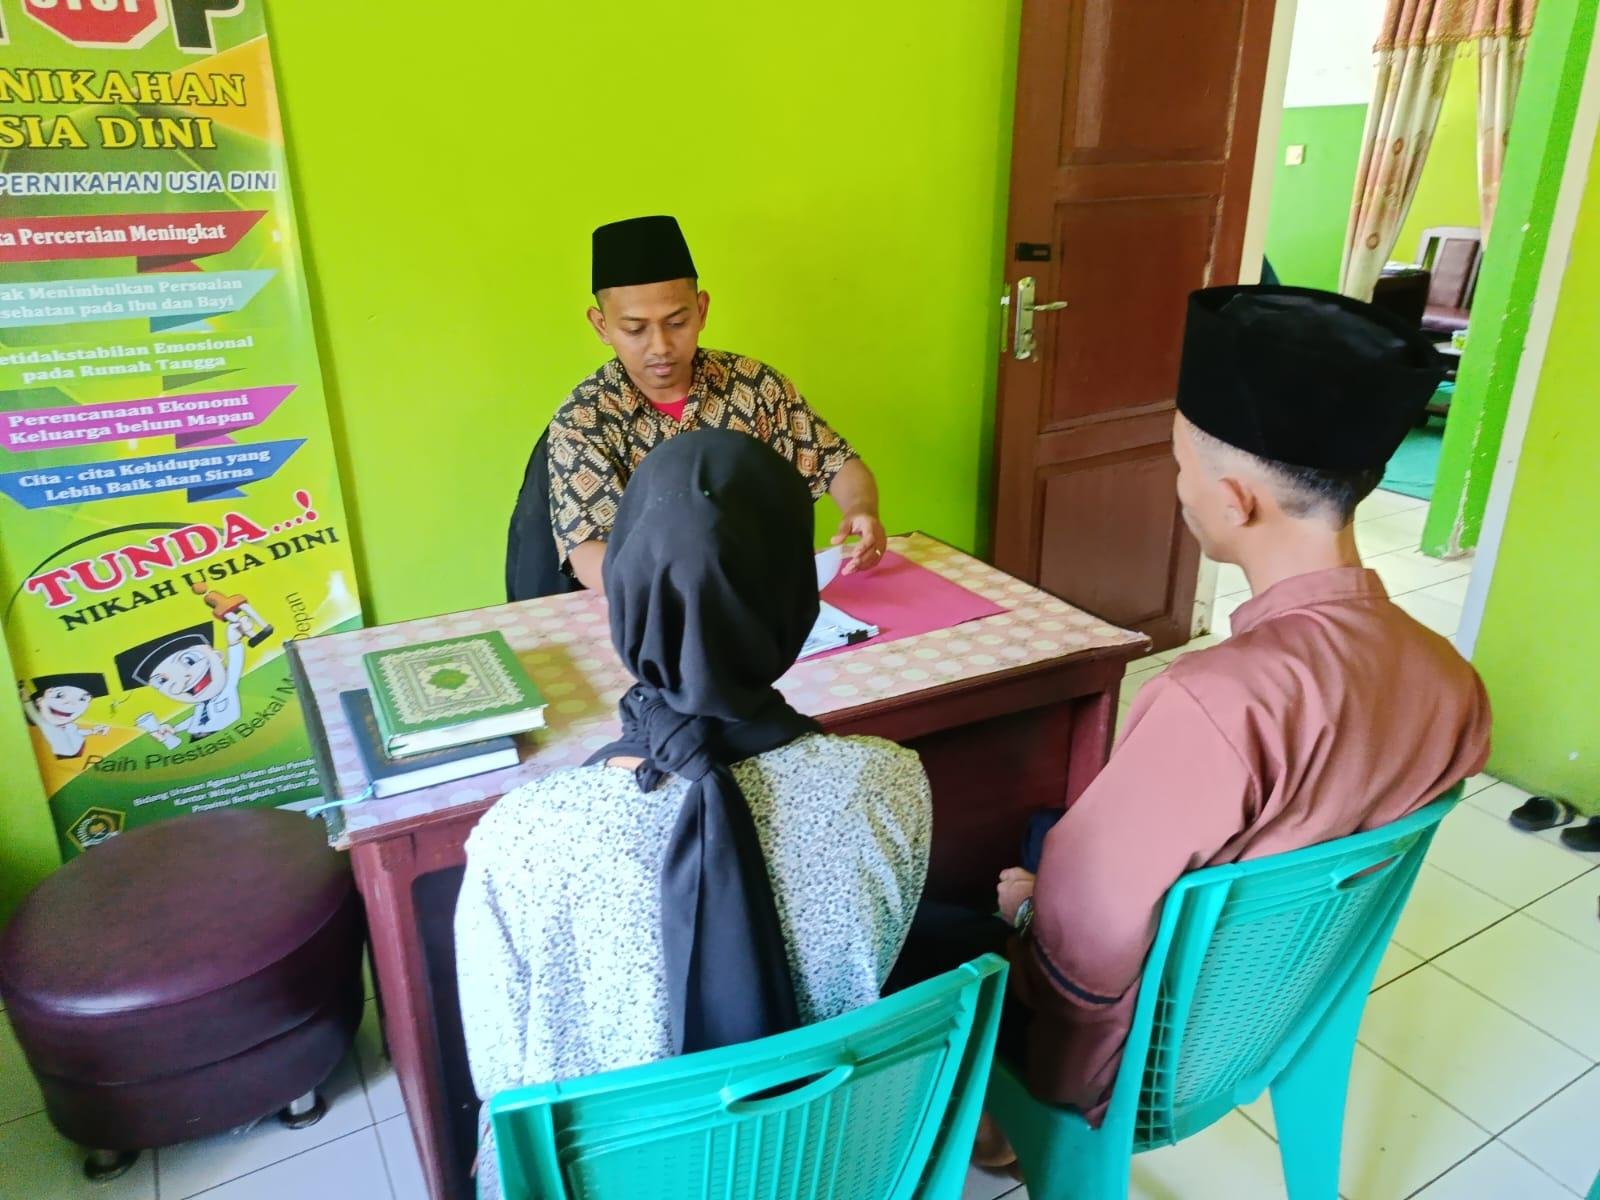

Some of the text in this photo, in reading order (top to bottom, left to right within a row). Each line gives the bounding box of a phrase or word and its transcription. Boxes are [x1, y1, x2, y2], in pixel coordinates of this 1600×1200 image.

[0, 68, 246, 105] NIKAHAN
[0, 114, 217, 149] SIA DINI
[169, 173, 222, 191] USIA
[230, 173, 276, 190] DINI
[18, 226, 127, 245] Perceraian
[129, 223, 226, 244] Meningkat
[29, 283, 155, 299] Menimbulkan
[158, 278, 242, 293] Persoalan
[80, 301, 124, 317] pada
[128, 299, 157, 312] Ibu
[161, 297, 193, 309] dan
[199, 295, 235, 309] Bayi
[0, 336, 253, 365] etidakstabilan Emosional
[22, 356, 226, 384] pada Rumah Tangga
[8, 394, 249, 428] Perencanaan Ekonomi
[9, 411, 255, 445] Keluarga belum Mapan
[19, 473, 61, 488] Cita
[77, 467, 116, 482] cita
[119, 453, 224, 476] Kehidupan
[226, 449, 271, 464] yang
[45, 467, 254, 502] Lebih Baik akan Sirna
[59, 527, 340, 631] NIKAH USIA DINI
[83, 754, 137, 773] Raih
[145, 731, 236, 769] Prestasi
[234, 695, 287, 738] Bekal
